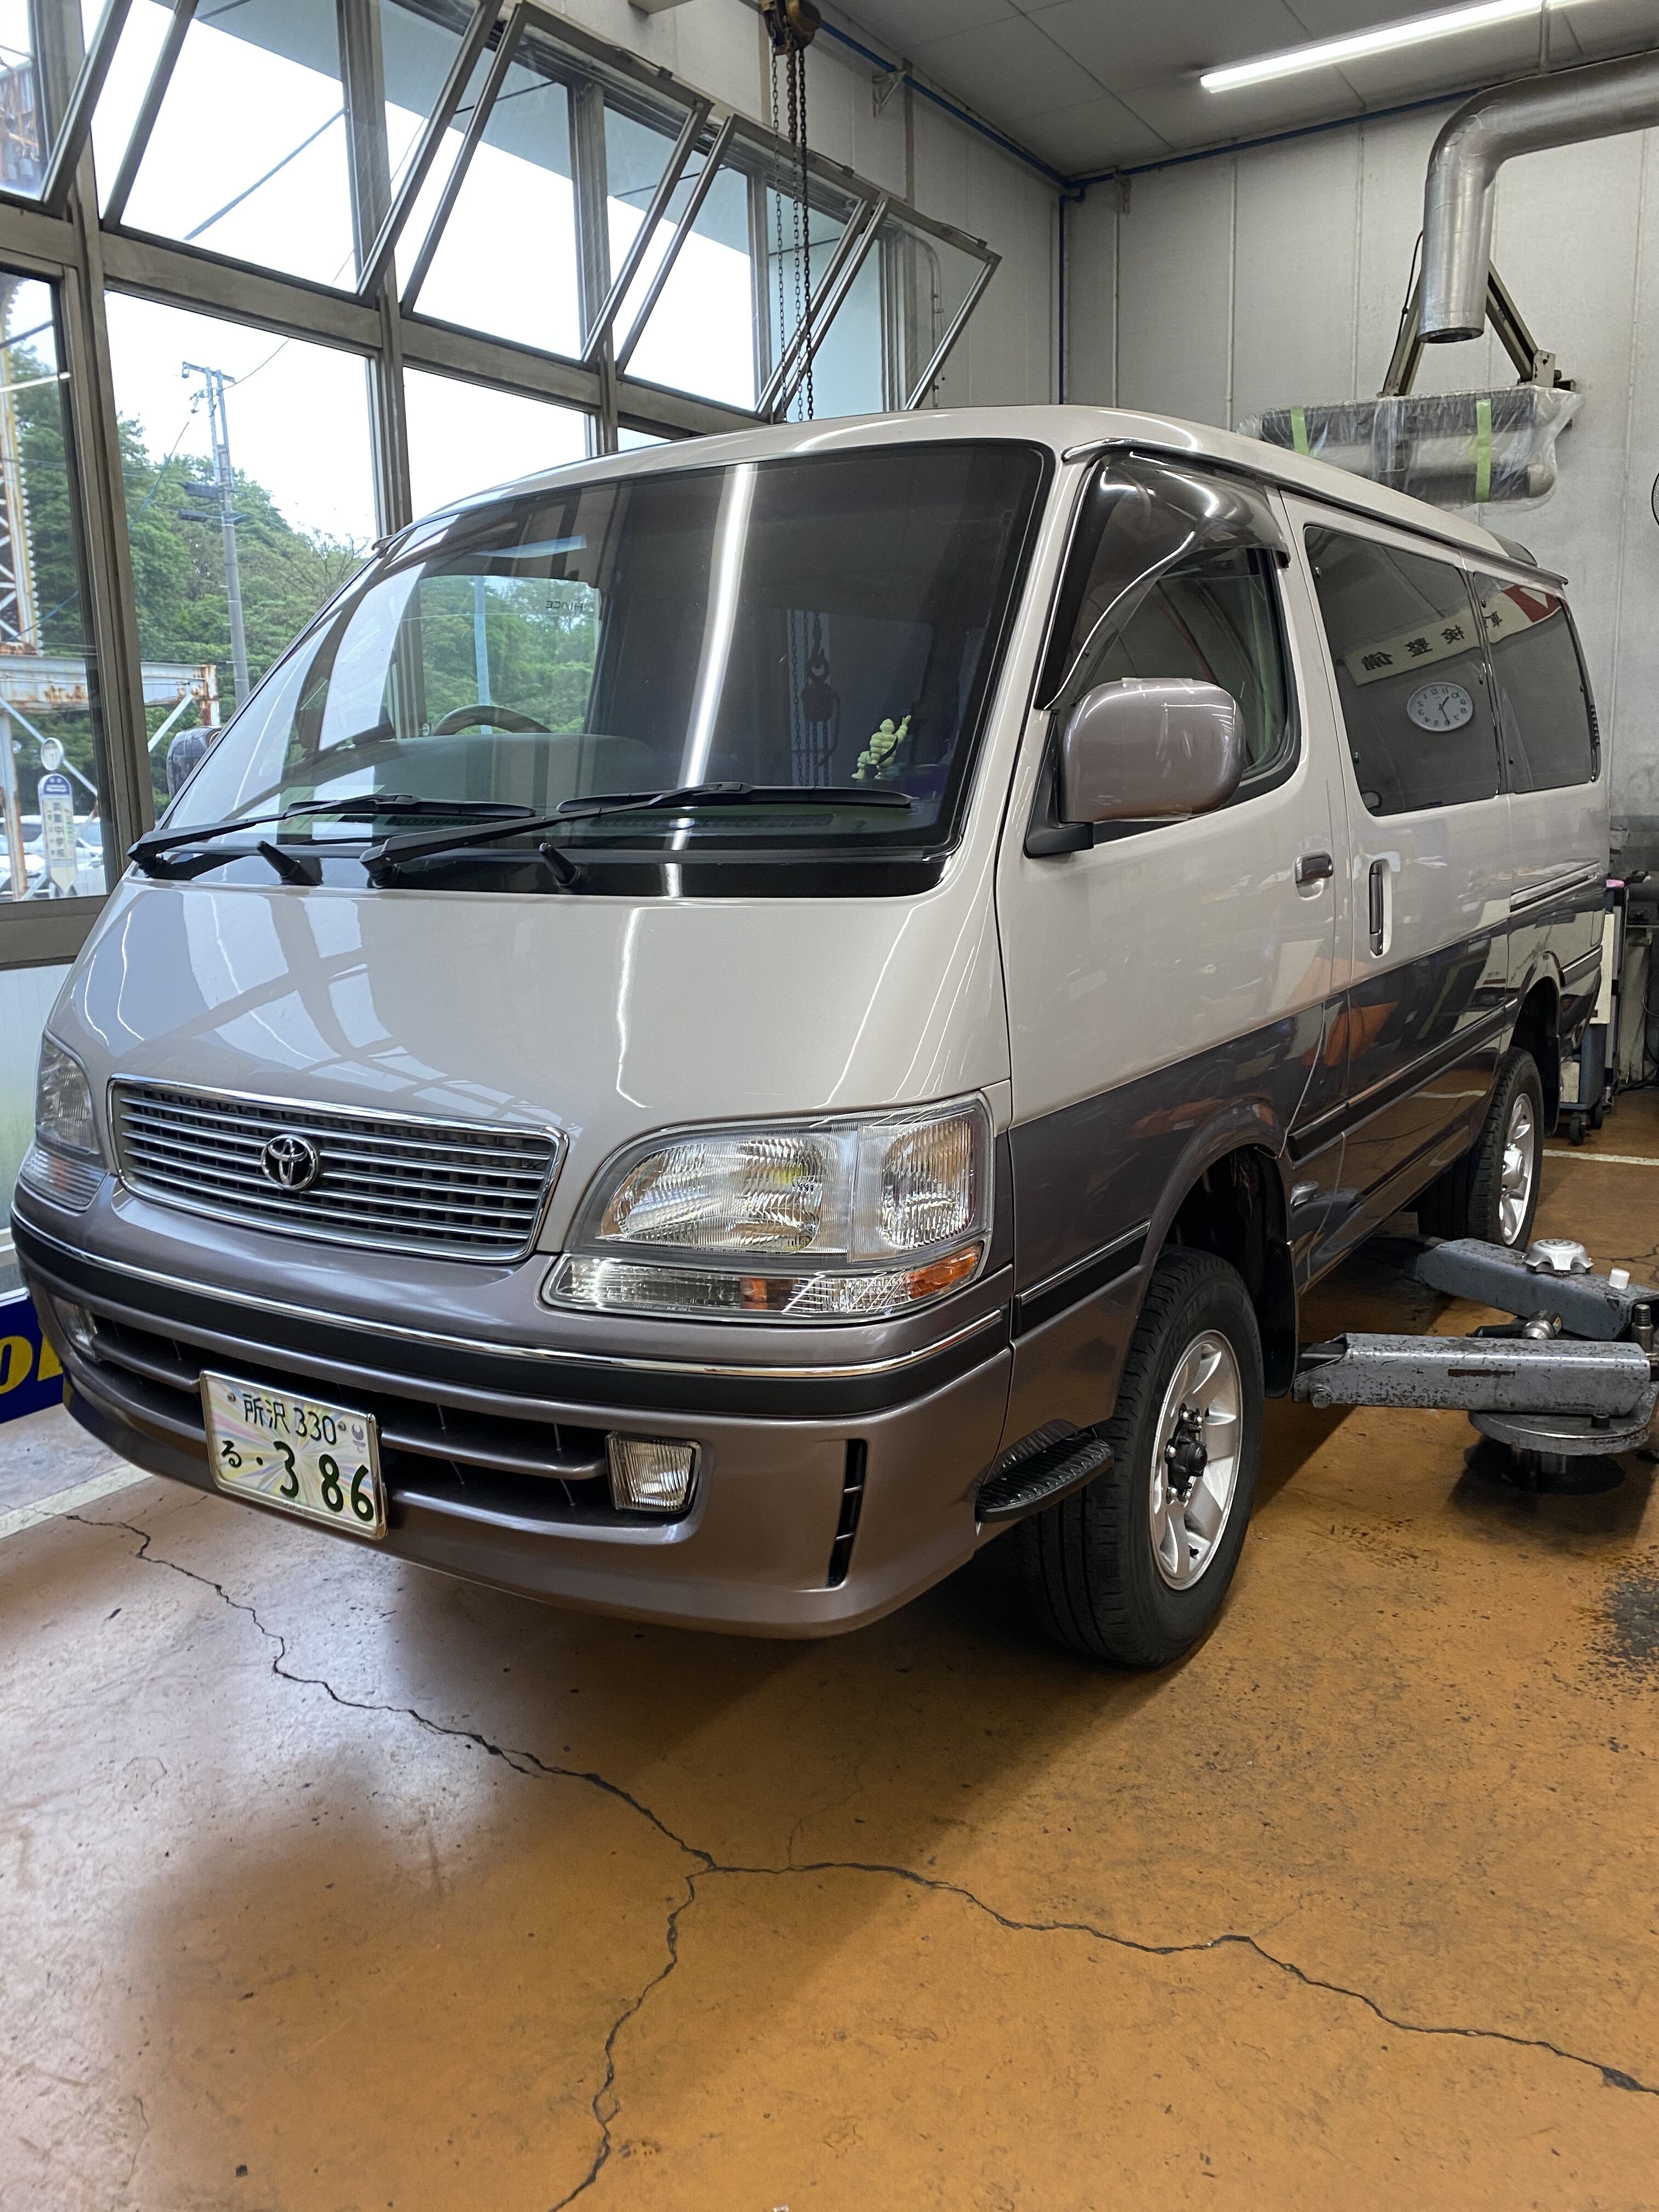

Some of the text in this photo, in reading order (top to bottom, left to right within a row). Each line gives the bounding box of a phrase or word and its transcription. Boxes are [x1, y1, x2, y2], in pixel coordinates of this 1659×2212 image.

[242, 1393, 337, 1445] 所沢 330
[221, 1440, 242, 1468] る
